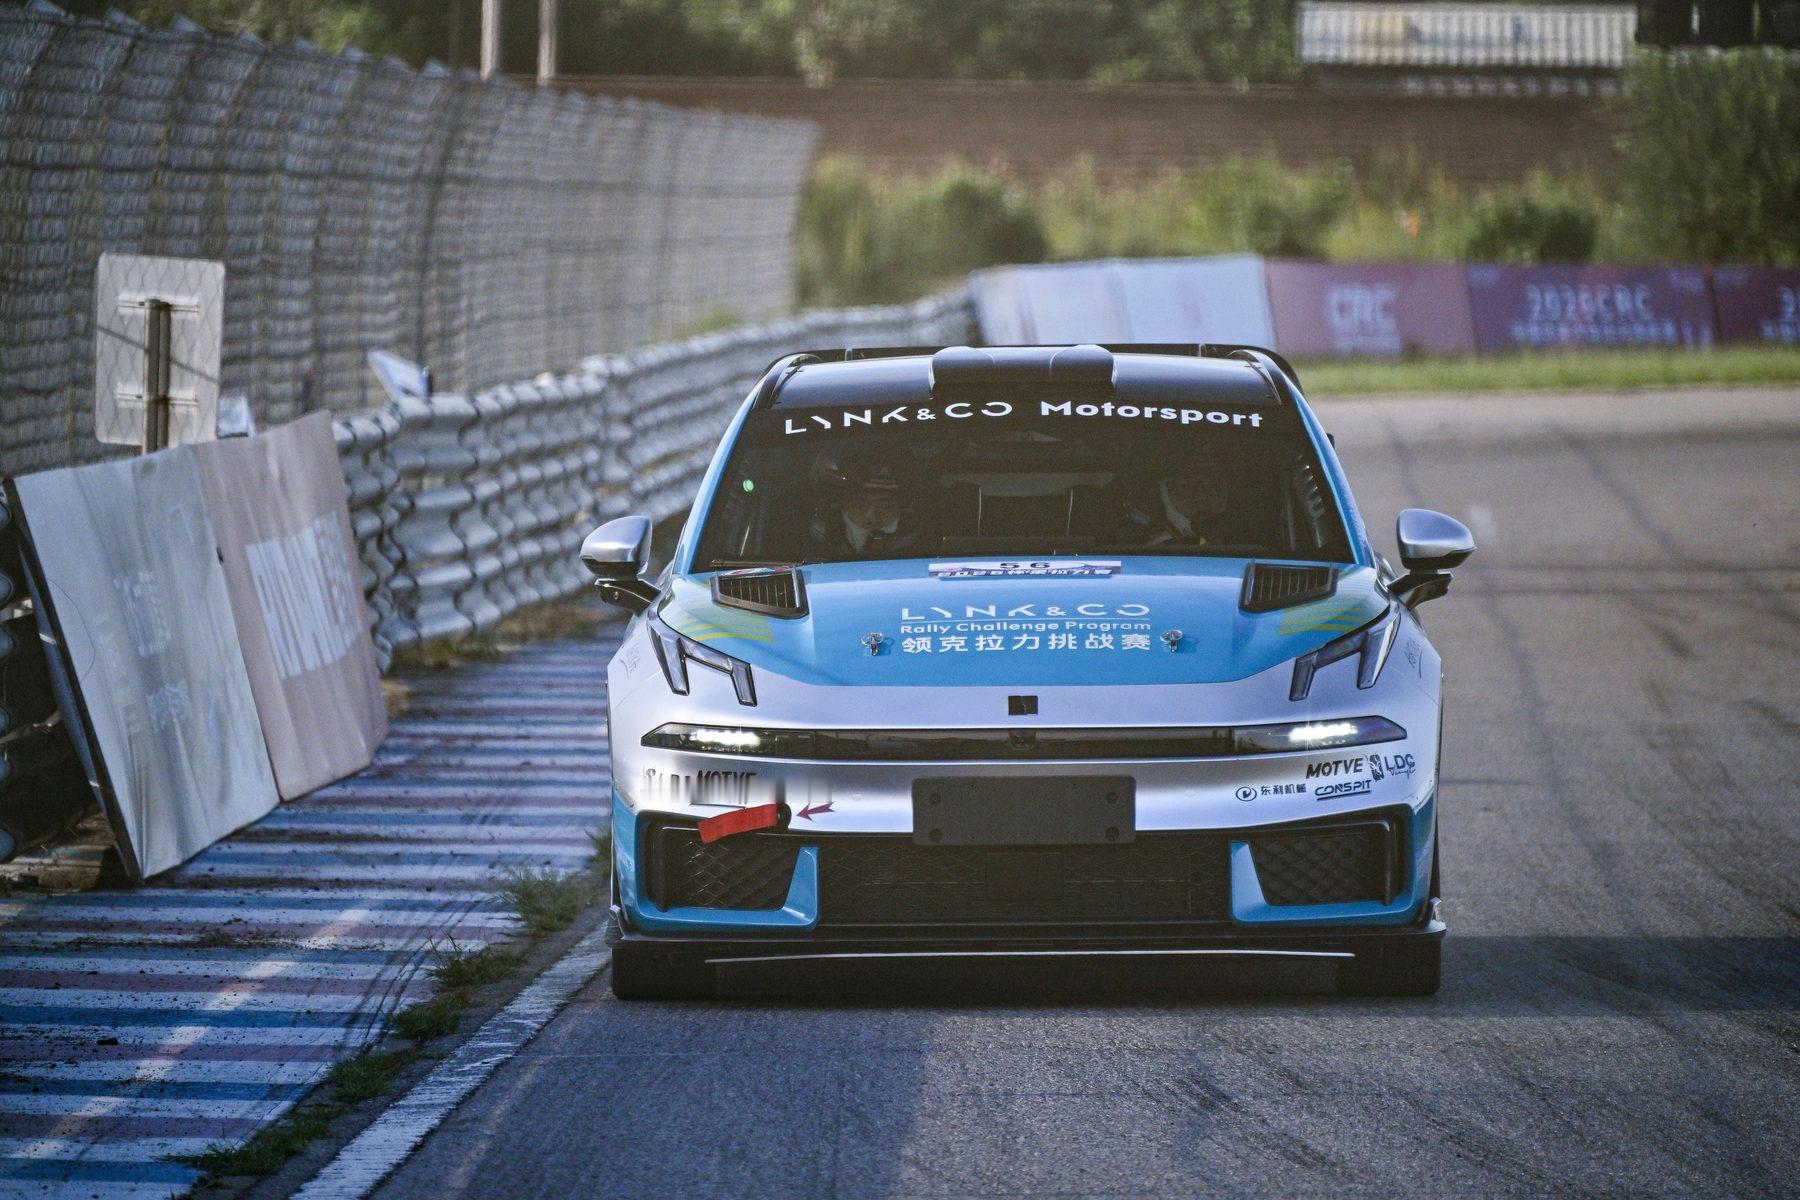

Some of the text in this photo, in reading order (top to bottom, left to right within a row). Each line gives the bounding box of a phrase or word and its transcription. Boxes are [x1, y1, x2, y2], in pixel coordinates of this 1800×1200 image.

[785, 401, 1263, 434] LYNK&CO Motorsport
[901, 604, 1150, 620] LYNK&CO
[901, 621, 1150, 634] Rally Challenge Program
[902, 633, 1150, 653] 领克拉力挑战赛
[1305, 757, 1364, 779] MOTVE
[1315, 779, 1372, 796] CONSPIT
